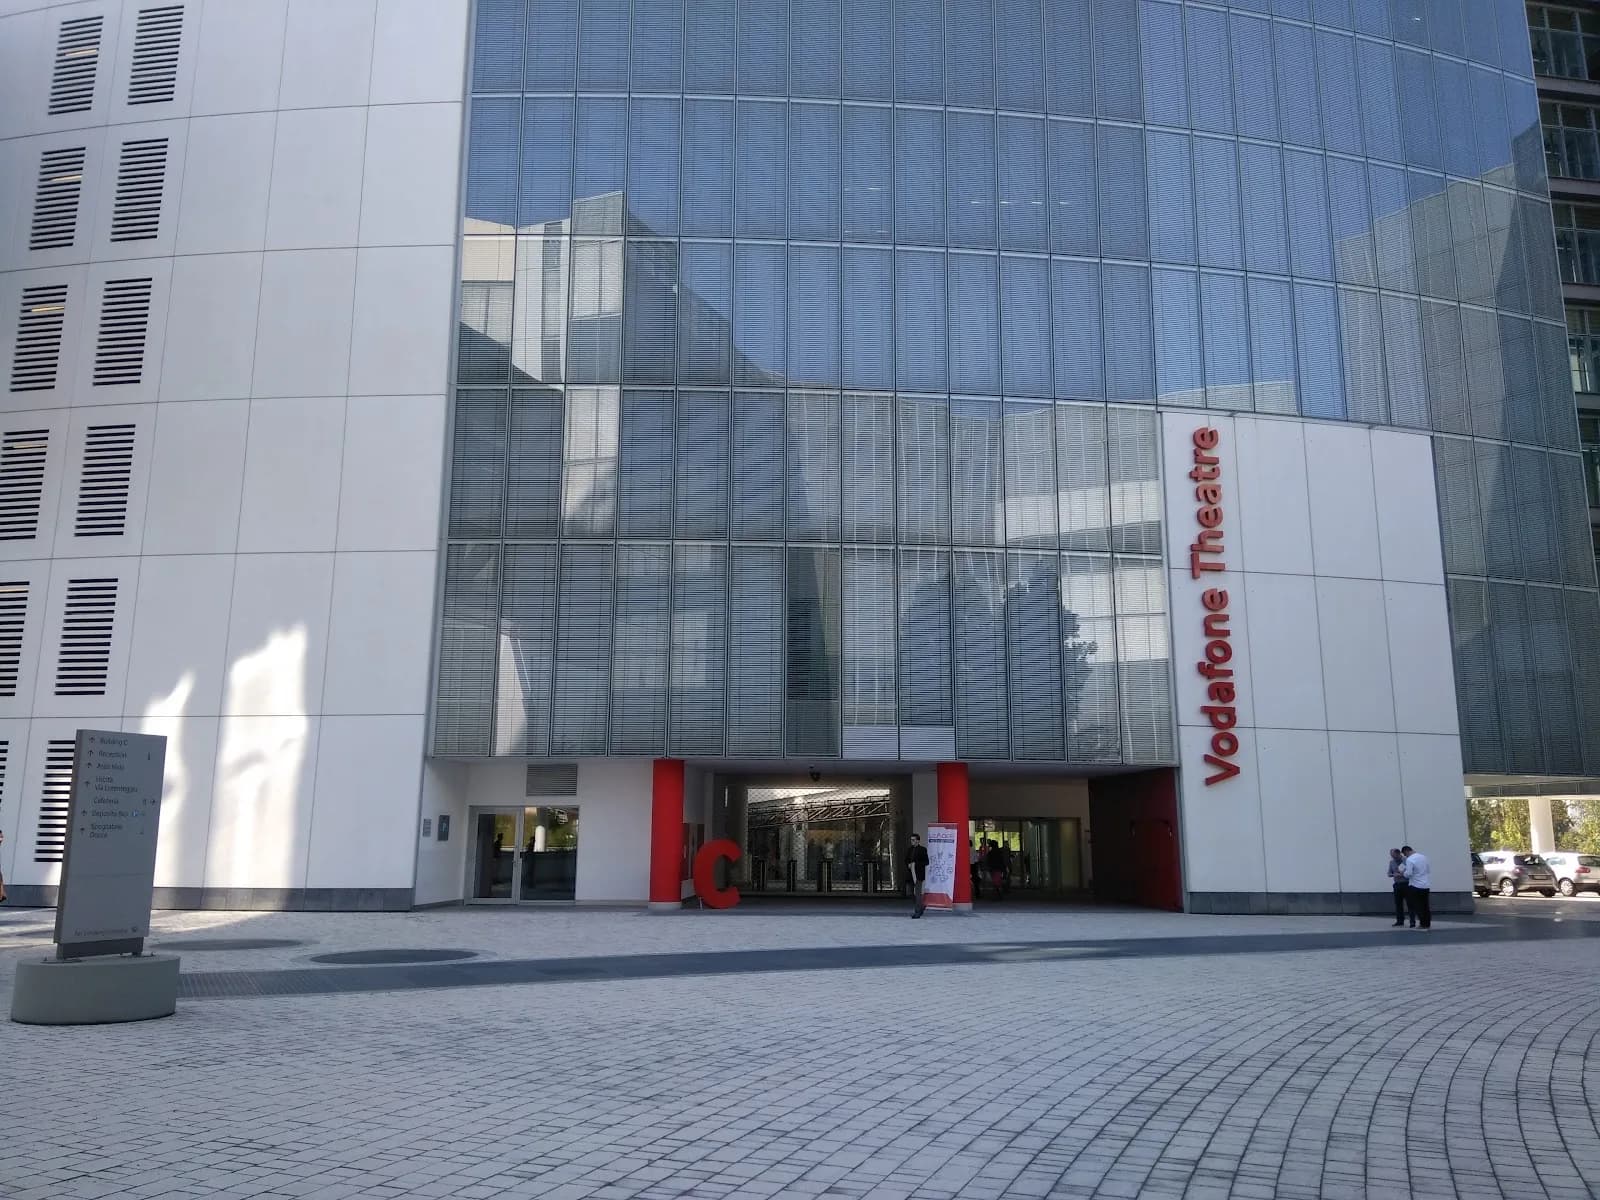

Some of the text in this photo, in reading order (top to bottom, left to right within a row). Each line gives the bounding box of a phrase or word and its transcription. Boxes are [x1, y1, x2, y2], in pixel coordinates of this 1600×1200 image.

[1189, 426, 1241, 787] Vodafone Theatre
[693, 838, 742, 910] C
